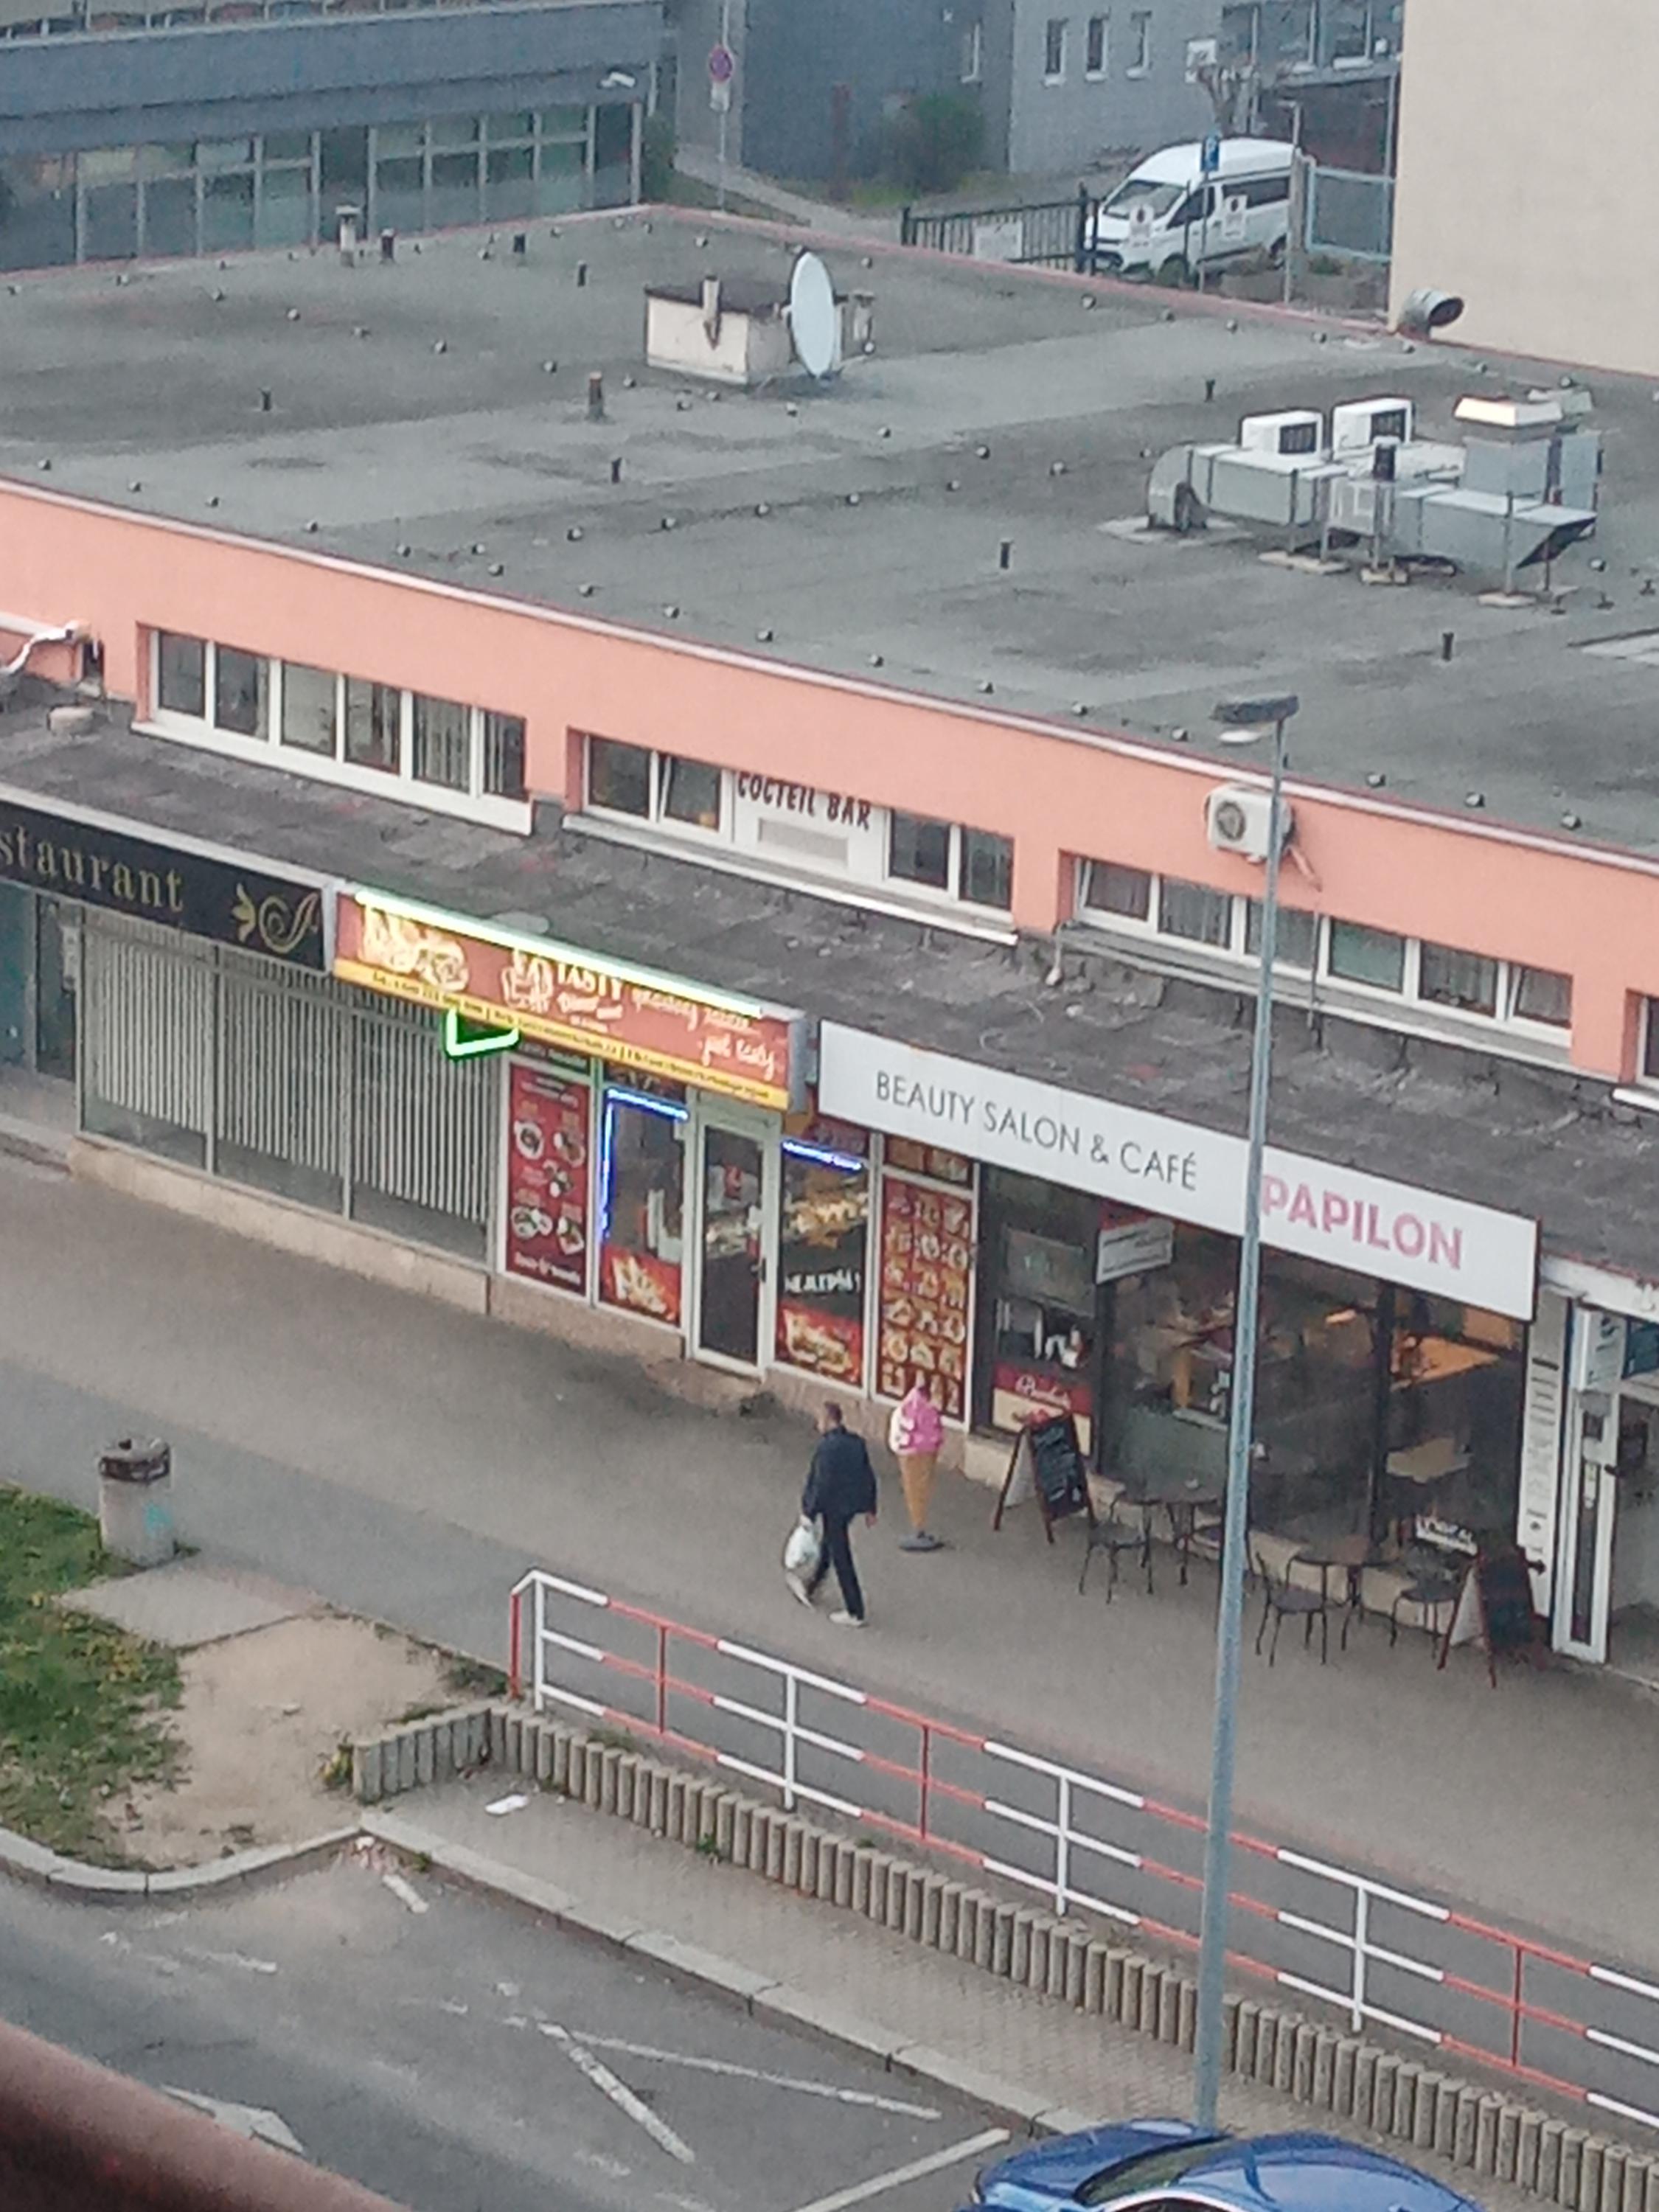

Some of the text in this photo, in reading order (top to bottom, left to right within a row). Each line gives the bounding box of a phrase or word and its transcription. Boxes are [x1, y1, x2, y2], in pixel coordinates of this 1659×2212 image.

[738, 771, 872, 832] COCTEIL BAR
[875, 1069, 1464, 1271] BEAUTY SALON & CAFÉ PAPILON
